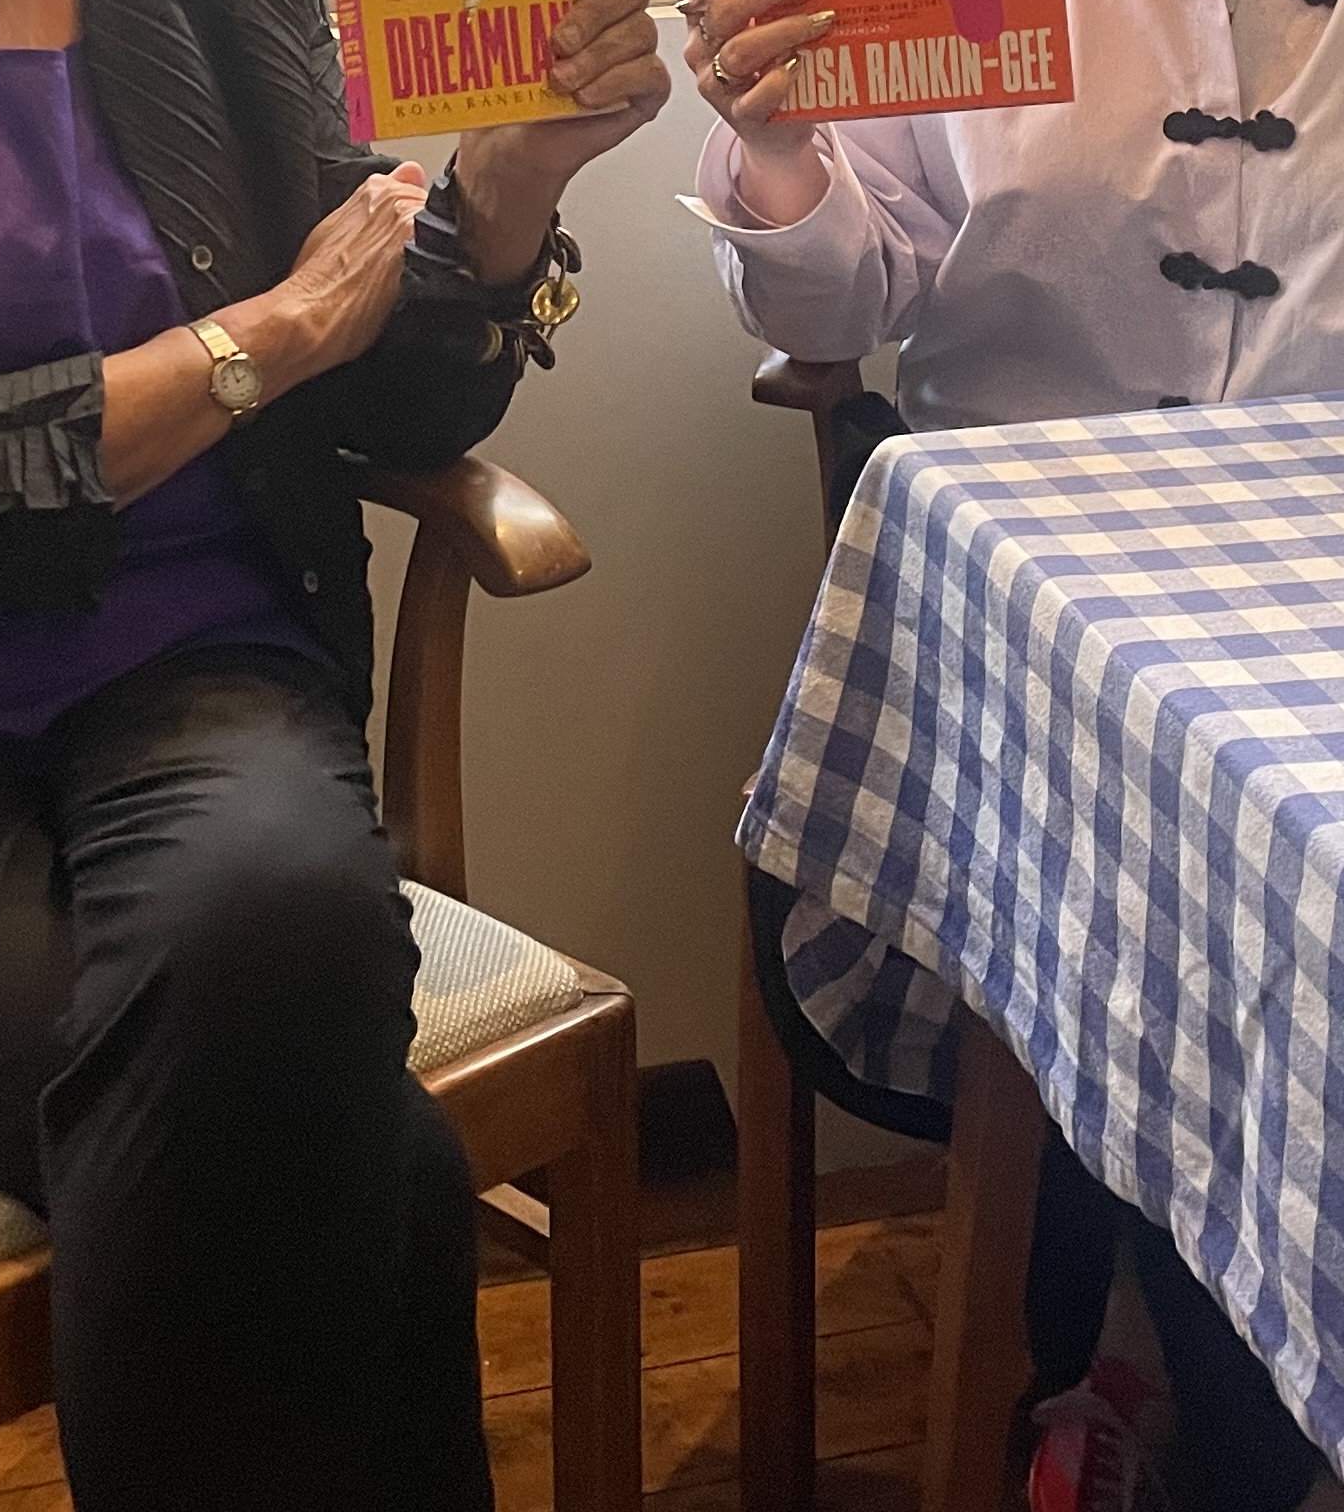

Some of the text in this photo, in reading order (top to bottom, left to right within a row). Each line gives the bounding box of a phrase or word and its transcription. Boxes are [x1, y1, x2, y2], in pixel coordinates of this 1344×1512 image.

[383, 1, 572, 102] DREAMLA
[865, 27, 1057, 105] RANKIN-GEE
[395, 88, 551, 118] ROSA RANKIN
